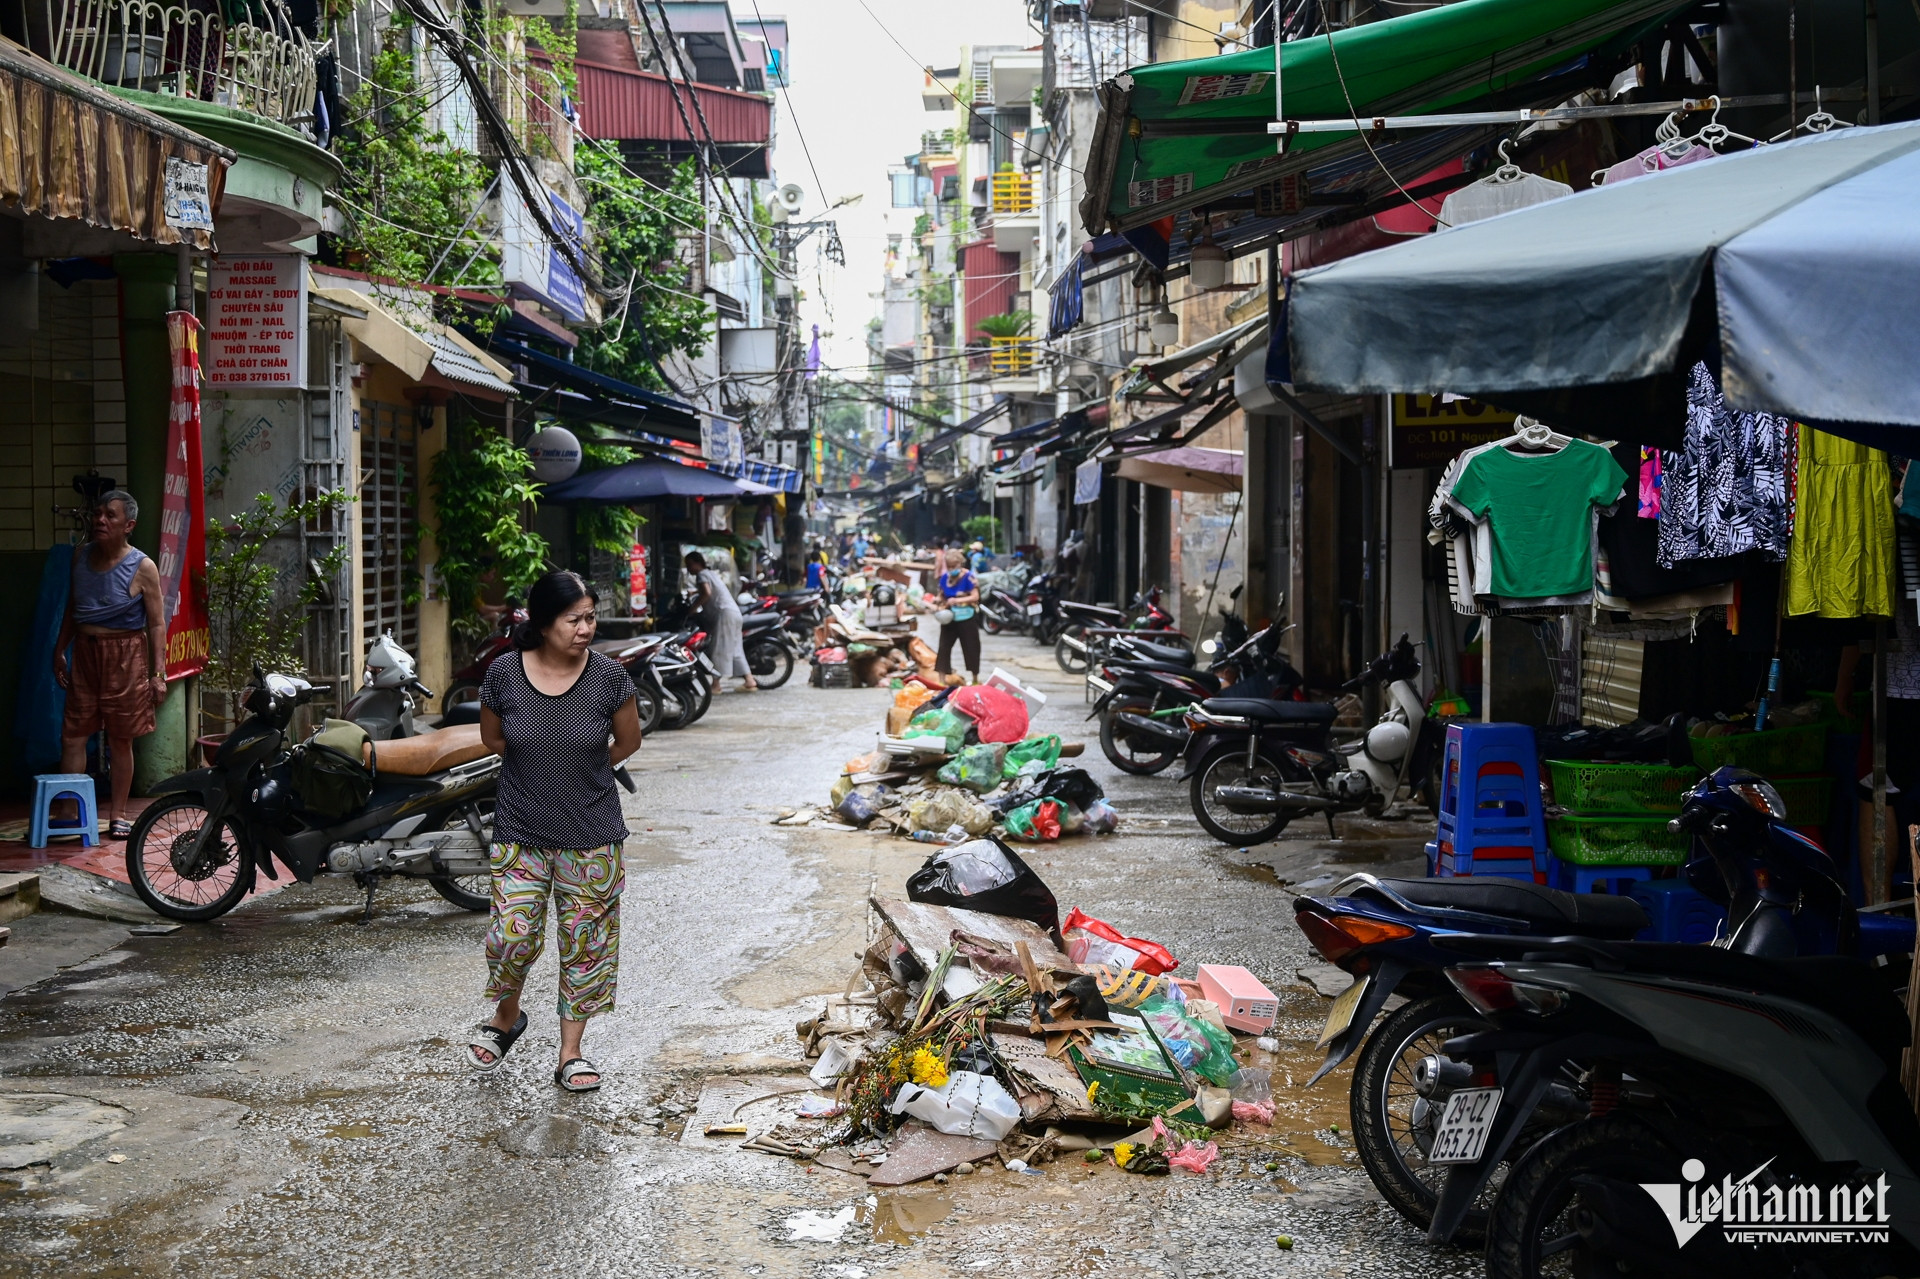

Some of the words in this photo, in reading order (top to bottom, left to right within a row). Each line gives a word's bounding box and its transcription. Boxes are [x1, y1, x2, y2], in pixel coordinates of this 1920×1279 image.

[229, 276, 277, 285] MASSAGE
[226, 290, 241, 299] VAI
[273, 290, 298, 298] BODY
[222, 302, 261, 312] CHUYÊN
[264, 302, 284, 312] SÂU
[262, 318, 285, 326] NAIL
[211, 331, 247, 342] NHUỘM
[260, 330, 272, 340] ÉP
[275, 330, 294, 340] TÓC
[249, 345, 280, 354] TRANG
[261, 357, 288, 368] CHÂN
[229, 373, 247, 381] 038
[250, 372, 291, 381] 3791051
[1430, 430, 1456, 443] 101
[454, 771, 492, 790] Future
[1447, 1092, 1491, 1124] 29-C2
[1433, 1126, 1484, 1159] 055.21
